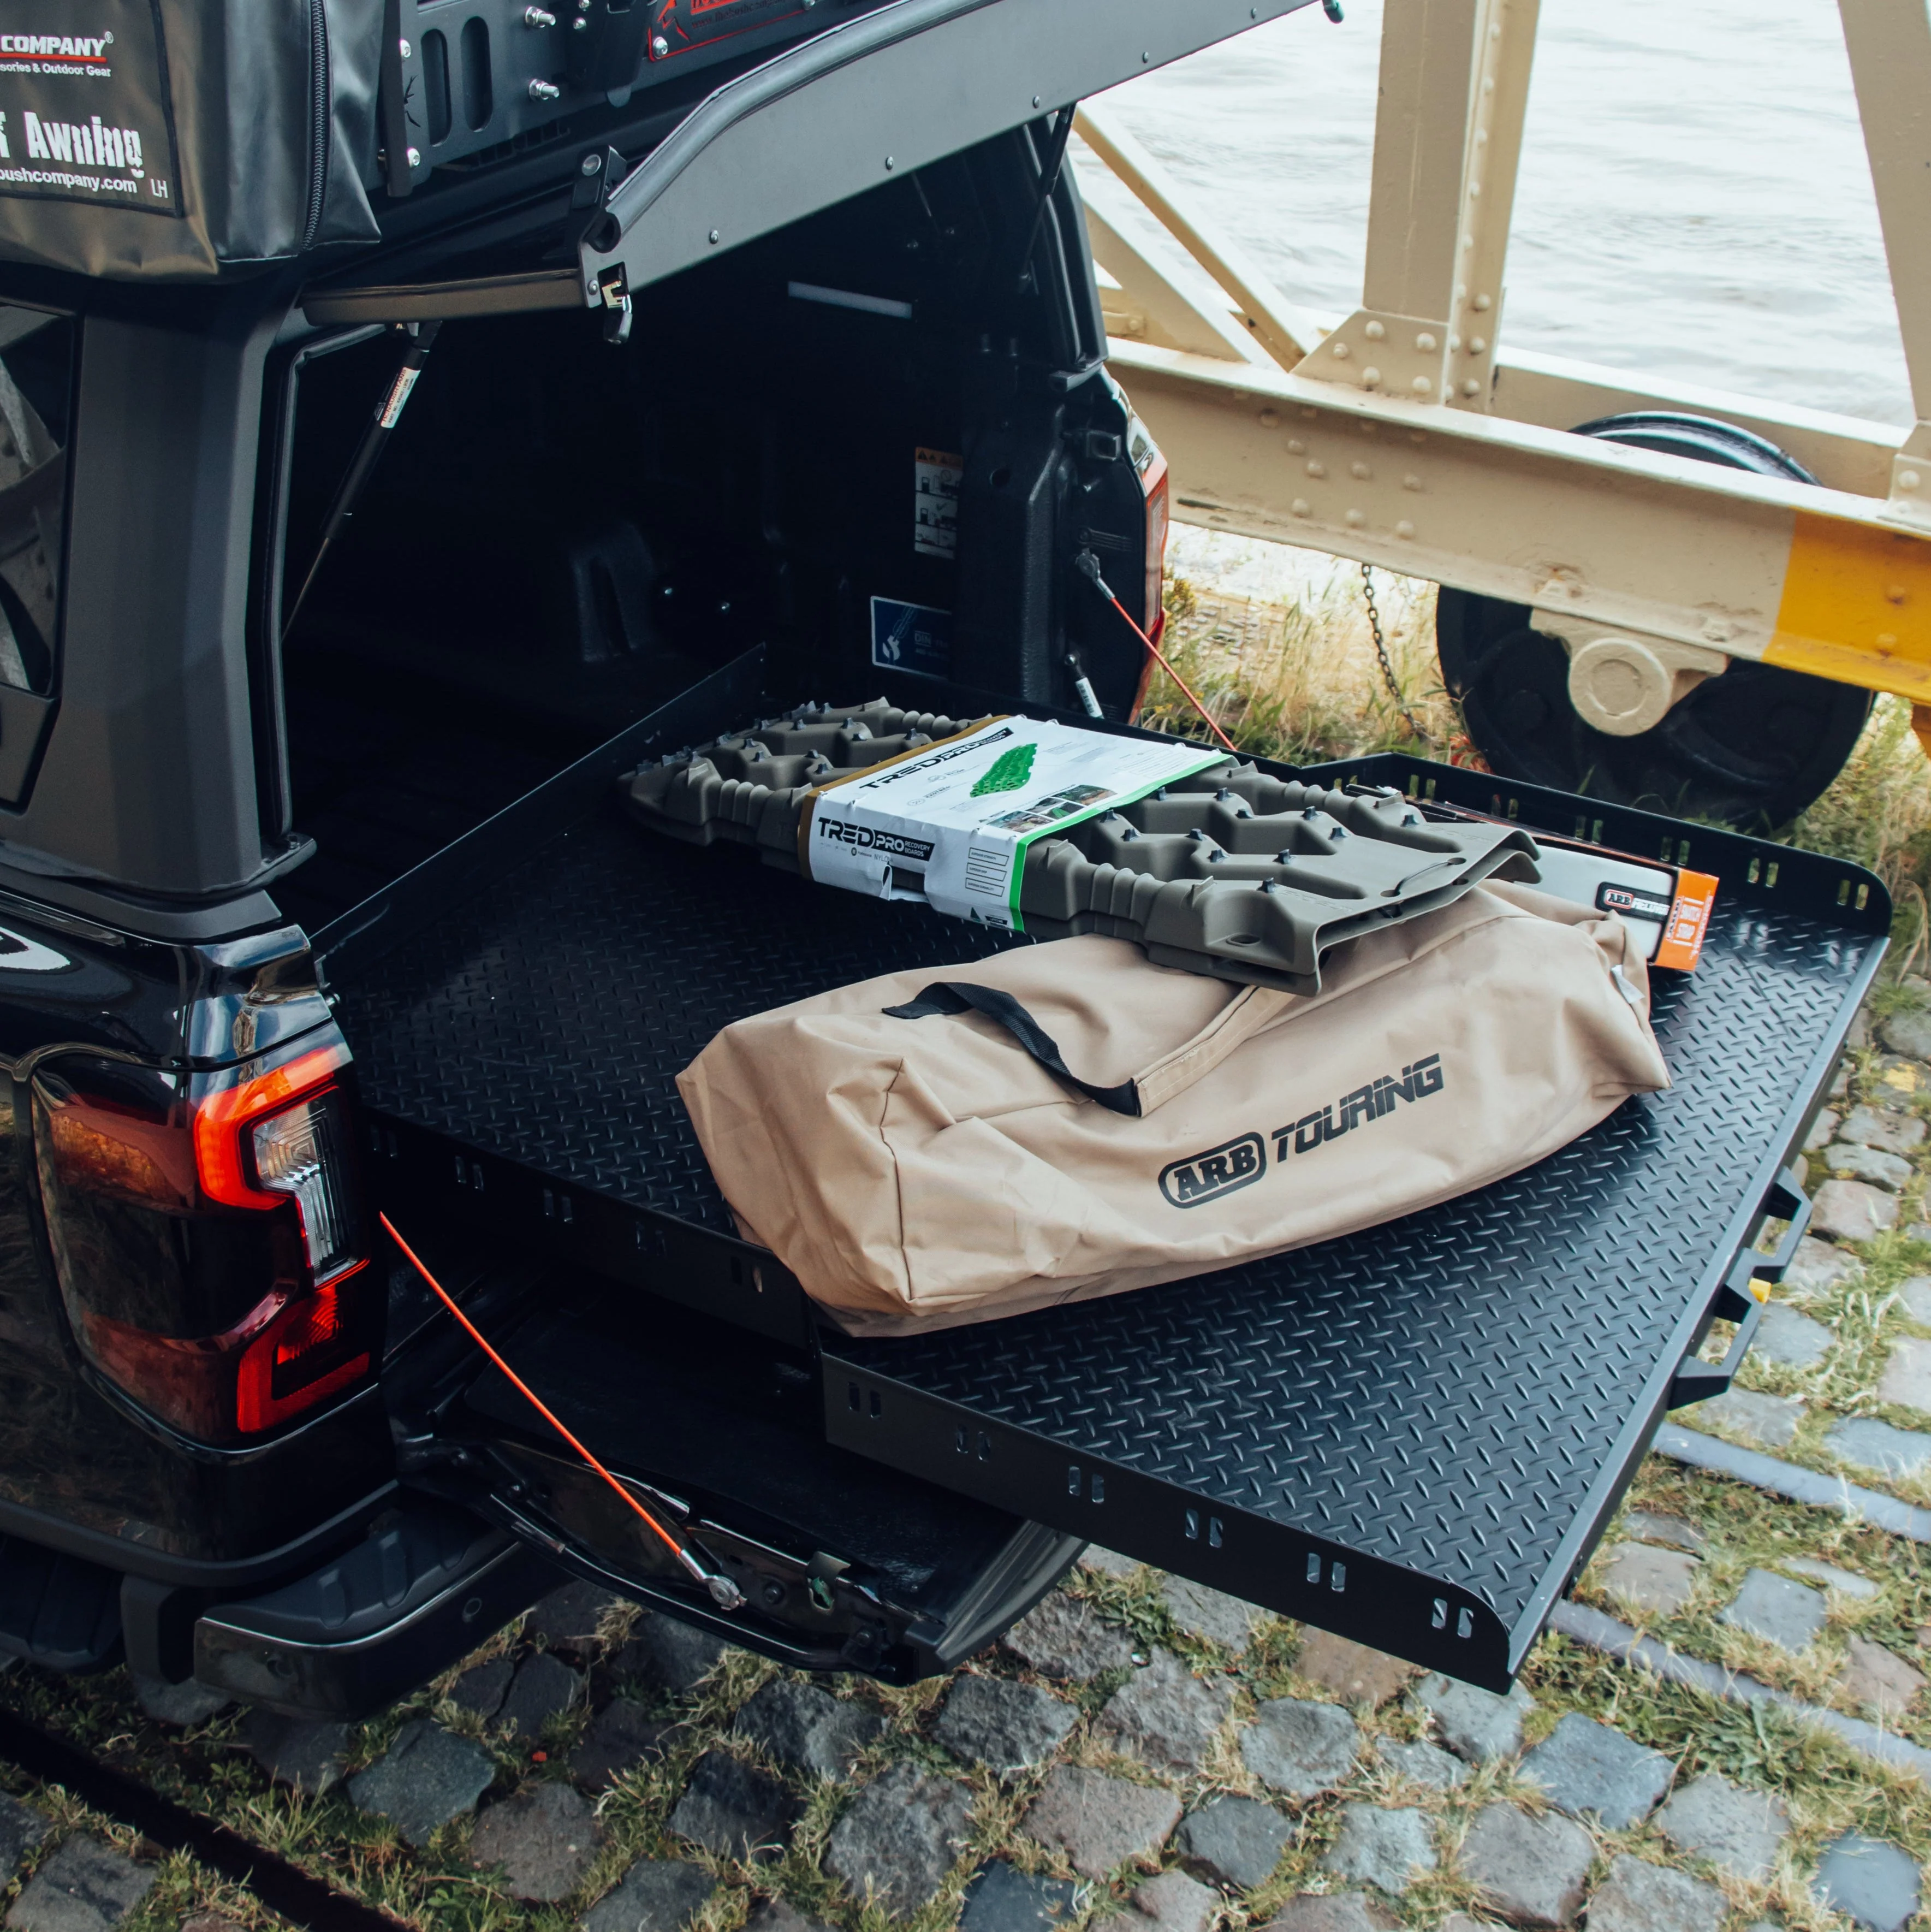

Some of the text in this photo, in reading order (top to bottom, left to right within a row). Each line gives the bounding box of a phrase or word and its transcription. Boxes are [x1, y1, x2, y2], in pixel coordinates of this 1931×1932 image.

[32, 63, 41, 73] &
[43, 63, 84, 75] Outdoor
[86, 65, 111, 77] Gear
[24, 111, 144, 178] Awning
[151, 179, 168, 198] LH
[905, 840, 930, 851] RECOVERY
[905, 848, 924, 857] BOARDS
[1173, 1053, 1444, 1202] ARB TOURING
